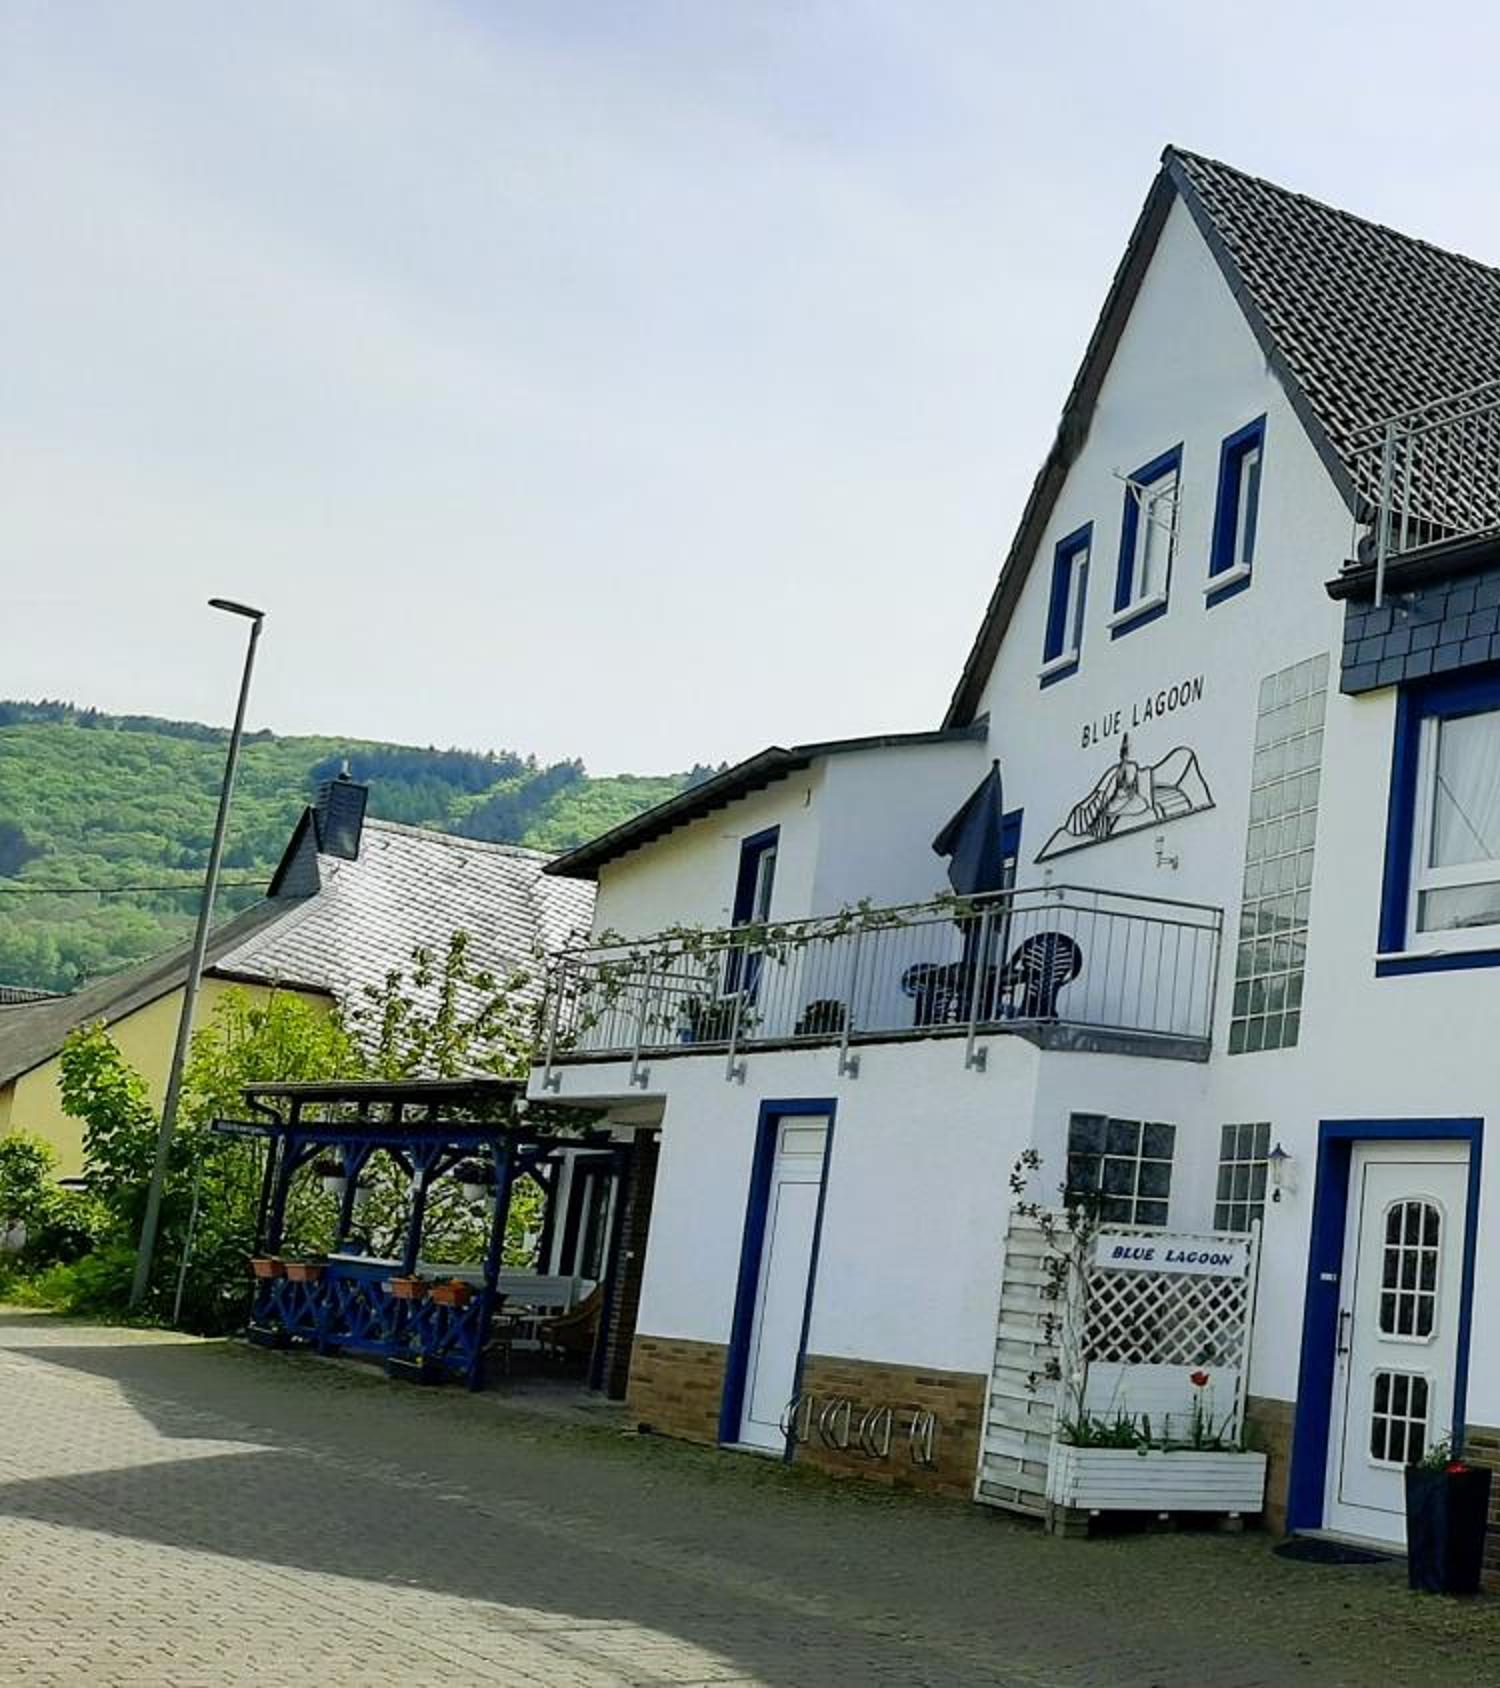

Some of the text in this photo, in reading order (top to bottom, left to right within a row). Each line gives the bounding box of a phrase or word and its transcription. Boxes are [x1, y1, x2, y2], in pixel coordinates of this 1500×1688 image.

[1082, 676, 1204, 748] BLUE LAGOON
[1112, 1246, 1233, 1266] BLUE LAGOON
